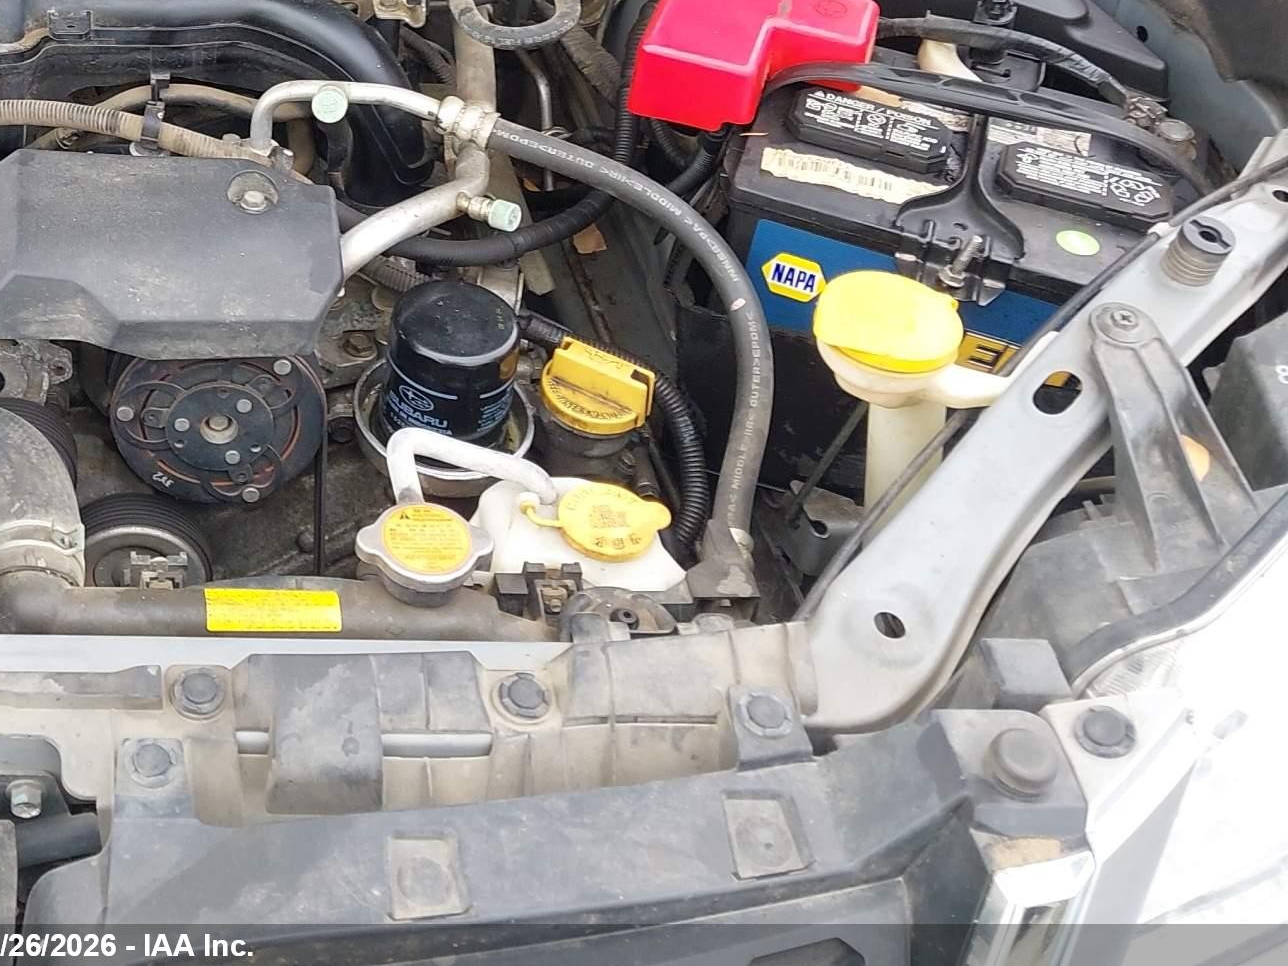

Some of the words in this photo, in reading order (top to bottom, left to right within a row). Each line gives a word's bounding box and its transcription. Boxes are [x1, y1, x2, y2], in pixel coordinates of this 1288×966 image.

[825, 92, 875, 111] DANGER
[886, 108, 933, 126] POISON
[770, 262, 817, 293] NAPA
[387, 389, 449, 429] SUBARU
